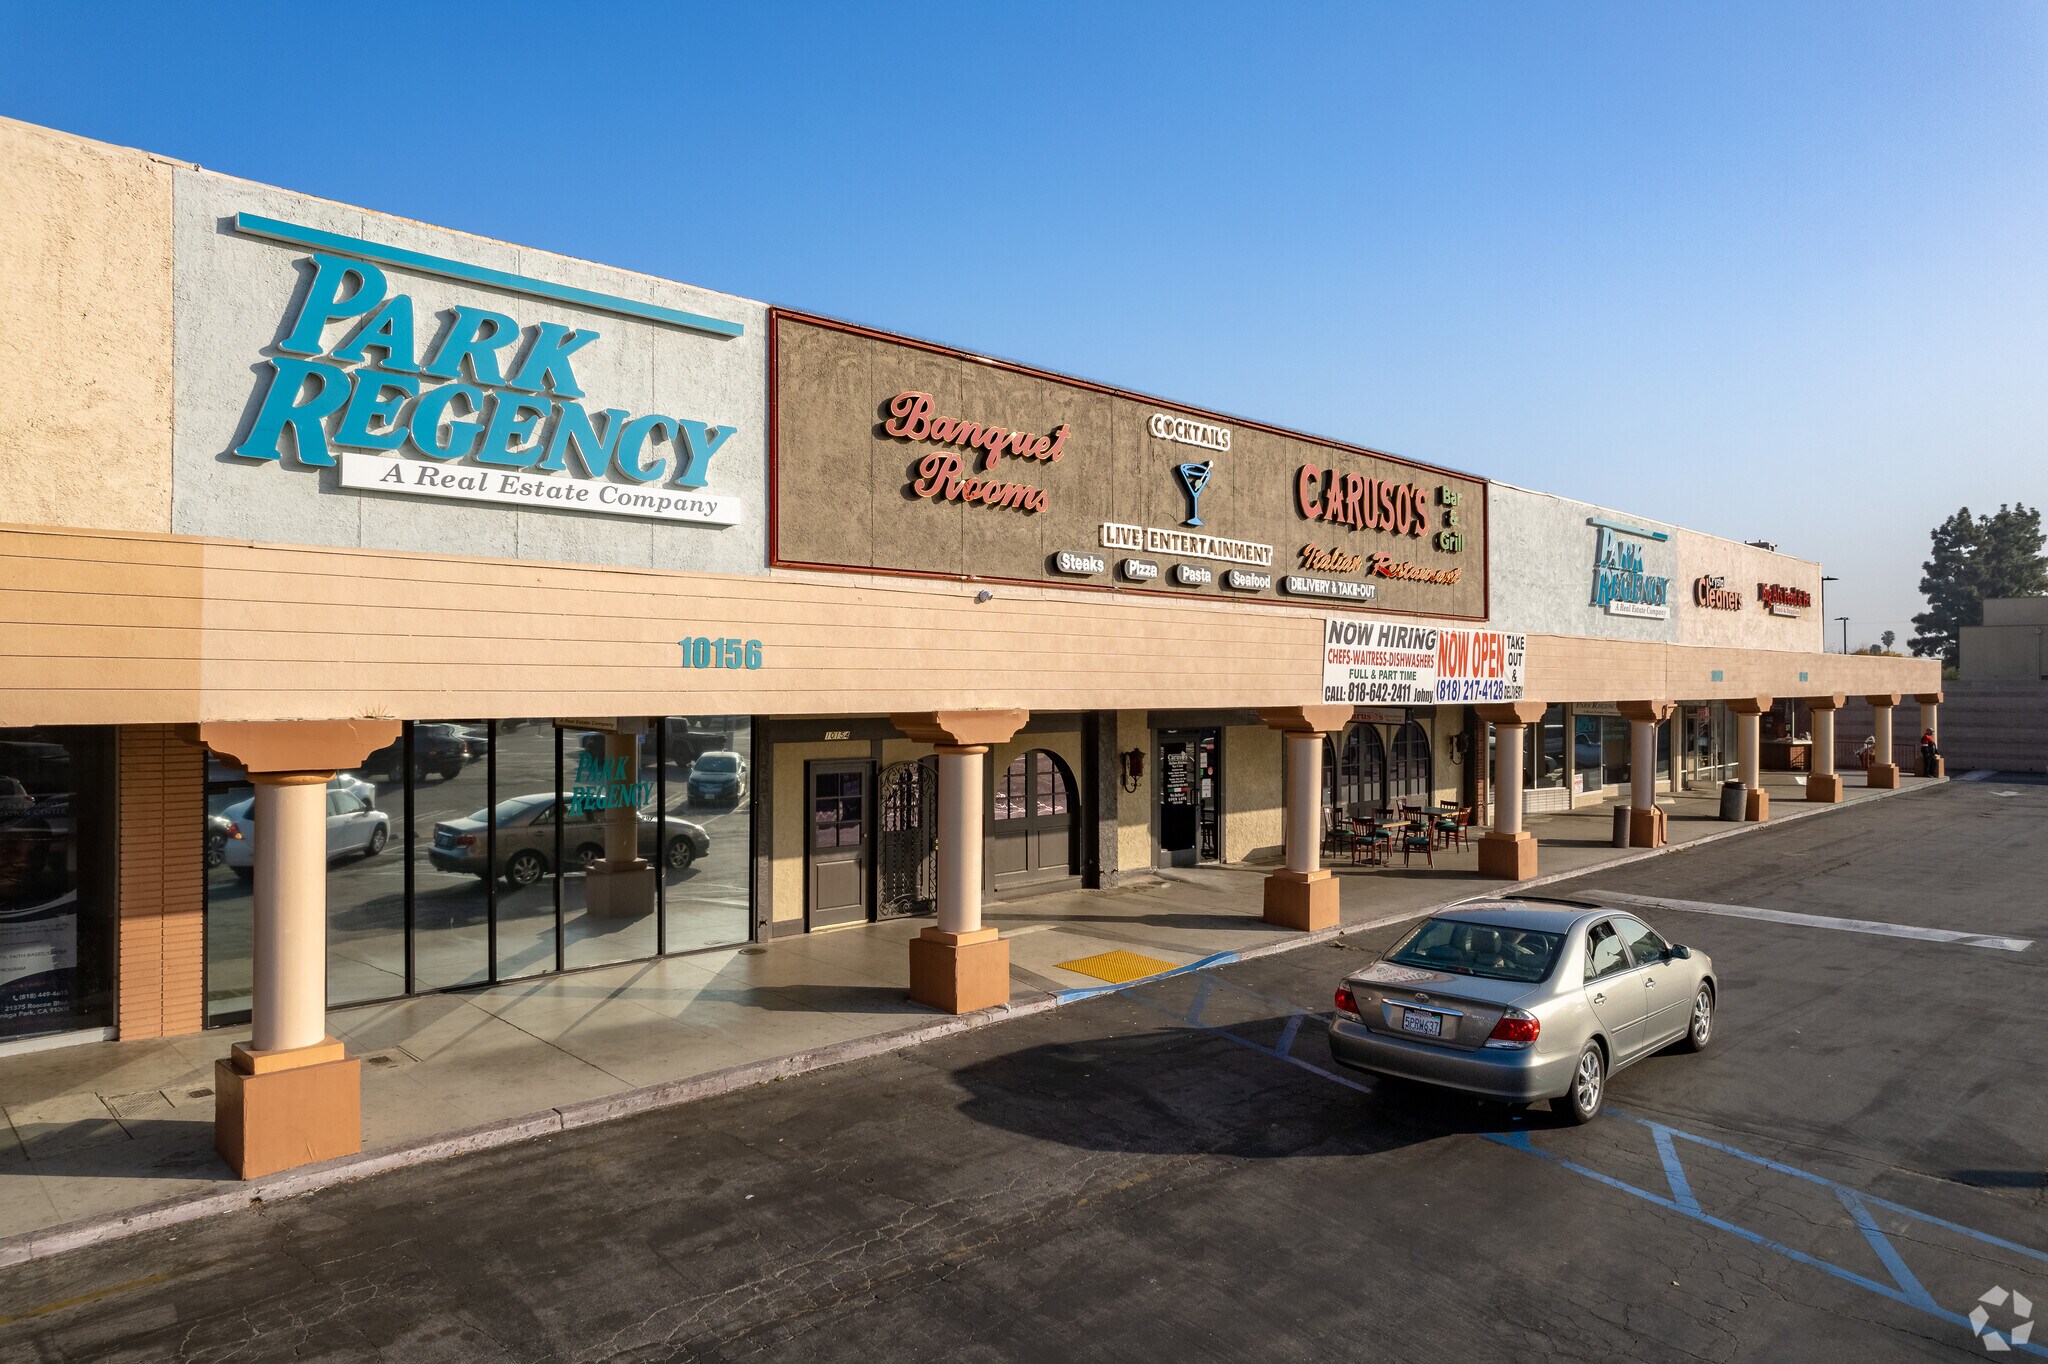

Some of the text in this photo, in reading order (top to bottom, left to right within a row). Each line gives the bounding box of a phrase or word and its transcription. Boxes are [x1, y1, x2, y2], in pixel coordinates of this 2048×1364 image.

[278, 253, 600, 399] PARK
[234, 356, 738, 489] REGENCY
[885, 391, 1071, 470] Banquet
[1152, 413, 1230, 451] COCKTAILS
[380, 463, 718, 517] A Real Estate Company
[914, 451, 1049, 513] Rooms
[1299, 463, 1431, 537] CARUSO'S
[1442, 485, 1462, 506] Bar
[1449, 510, 1458, 526] &
[1103, 522, 1273, 566] LIVE ENTERTAINMENT
[1439, 531, 1464, 552] Grill
[1600, 526, 1644, 572] PARK
[1060, 552, 1104, 572] Steaks
[1302, 543, 1462, 585] Italian Restaurant
[1182, 566, 1212, 583] Pasta
[1232, 571, 1271, 588] Seafood
[1290, 576, 1375, 599] DELIVERY & TAKE-OUT
[1596, 567, 1671, 607] REGENCY
[1699, 577, 1743, 610] Cleaners
[1614, 603, 1667, 617] A Real Estate Company
[1328, 621, 1437, 651] NOW HIRING
[1507, 636, 1525, 650] TAKE
[678, 636, 763, 670] 10156
[1327, 649, 1434, 669] CHEFS-WAITRESS-DISHWASHERS
[1437, 630, 1505, 678] NOW OPEN
[1508, 652, 1522, 667] OUT
[1349, 669, 1417, 681] FULL & PART TIME
[1511, 669, 1518, 683] &
[1324, 682, 1434, 704] CALL: 818-642-2411 Johny
[1436, 680, 1504, 702] (818) 217-4128
[1504, 685, 1523, 700] DELIVERY
[592, 721, 615, 730] Company
[575, 752, 630, 785] PARK
[569, 782, 654, 817] REGENCY
[1405, 1016, 1439, 1032] 5PRW637
